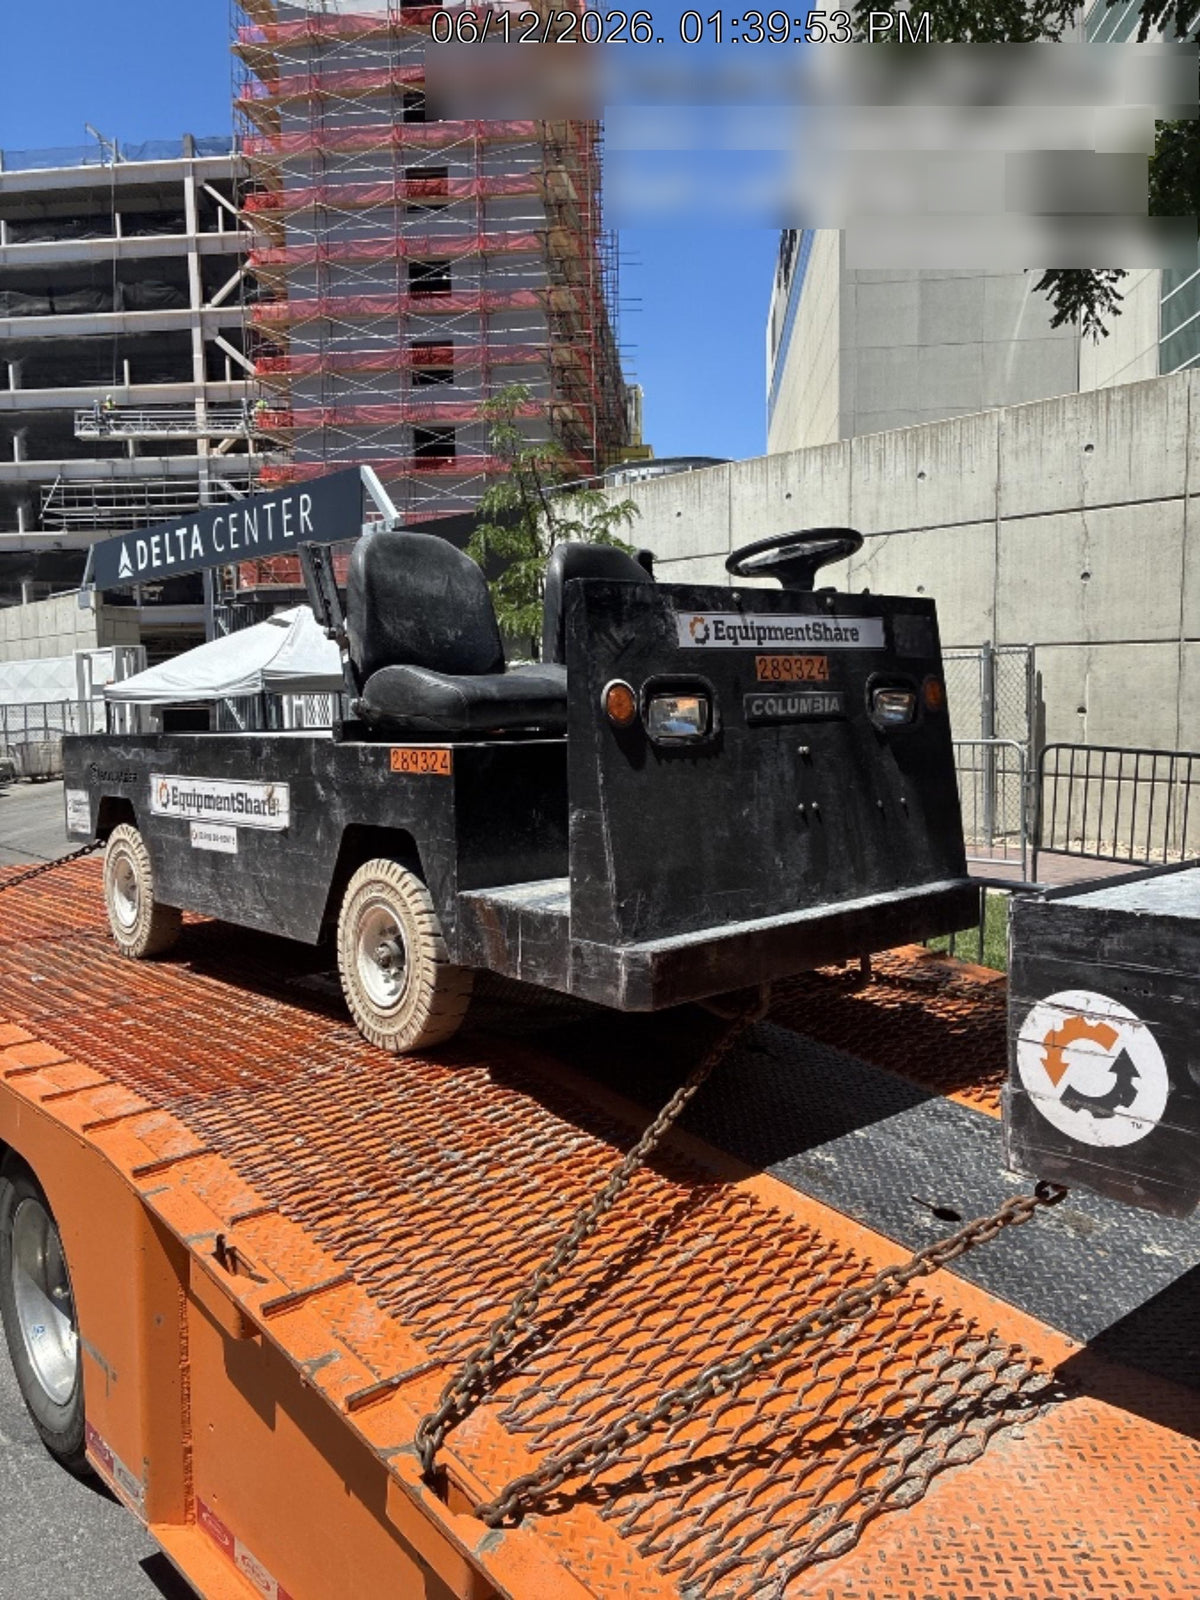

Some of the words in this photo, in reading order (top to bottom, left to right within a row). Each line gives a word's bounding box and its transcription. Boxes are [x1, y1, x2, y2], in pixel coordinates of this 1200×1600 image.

[135, 523, 204, 571] DELTA
[211, 493, 314, 553] CENTER
[712, 619, 860, 646] EquipmentShare
[757, 657, 828, 681] 289324
[751, 696, 841, 716] COLUMBIA
[391, 750, 449, 772] 289324
[171, 785, 279, 817] EquipmentShare
